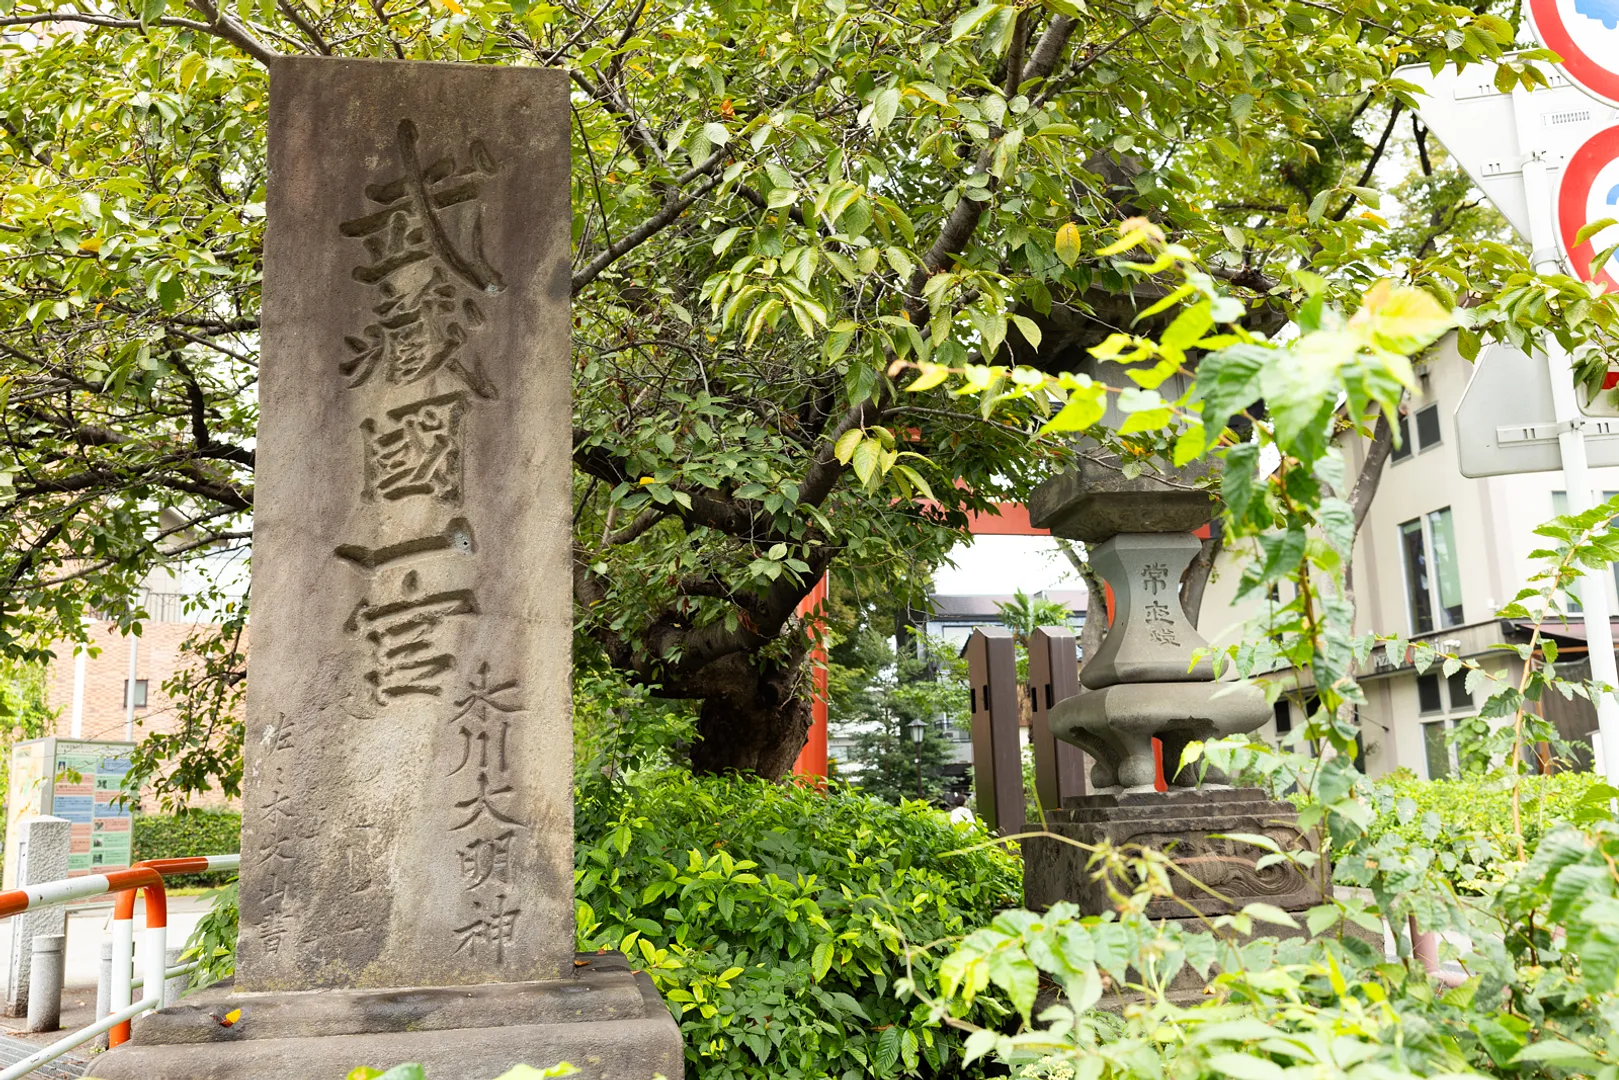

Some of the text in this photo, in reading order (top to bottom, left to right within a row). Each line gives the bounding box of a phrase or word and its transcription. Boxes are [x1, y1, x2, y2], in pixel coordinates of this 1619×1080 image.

[446, 660, 530, 965] 氷川大明神
